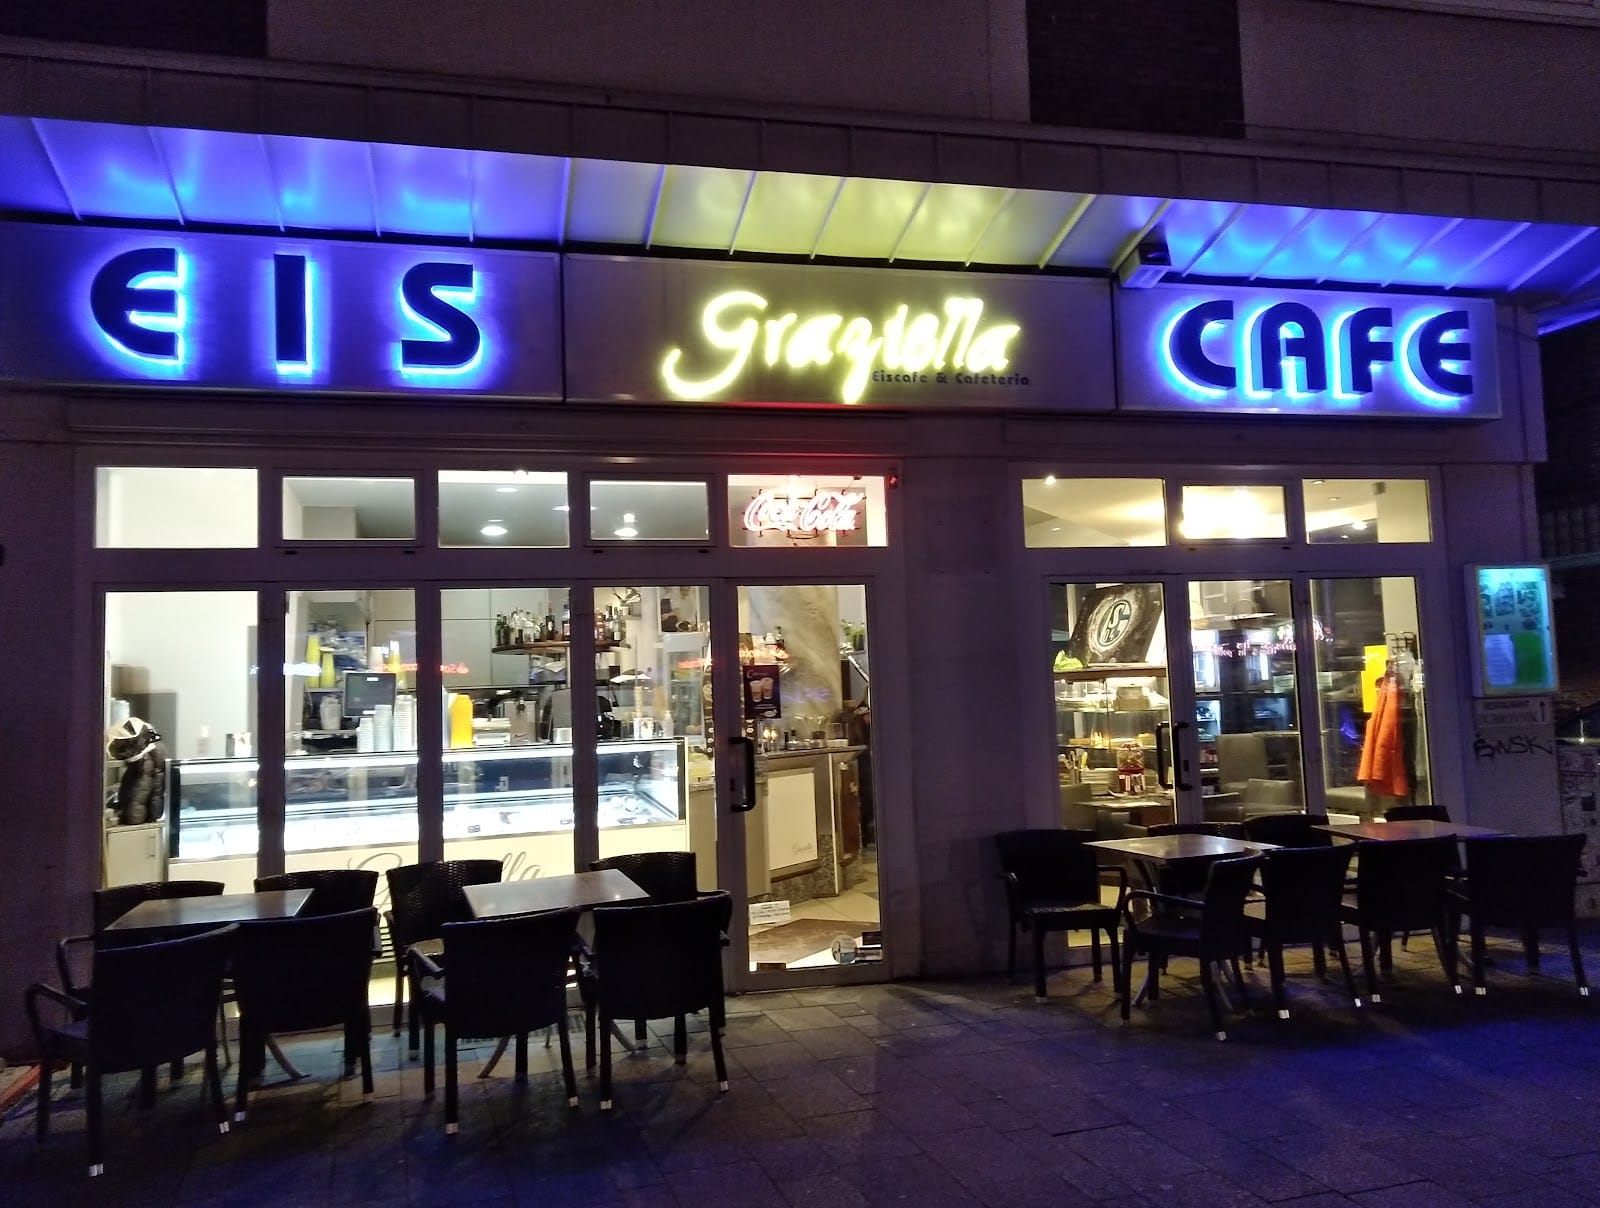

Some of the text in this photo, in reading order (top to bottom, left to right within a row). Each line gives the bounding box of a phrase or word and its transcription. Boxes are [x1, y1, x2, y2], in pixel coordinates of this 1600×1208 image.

[90, 247, 483, 369] EIS
[1165, 299, 1474, 399] CAFE
[935, 372, 947, 385] &
[955, 372, 1030, 386] Cafeteria
